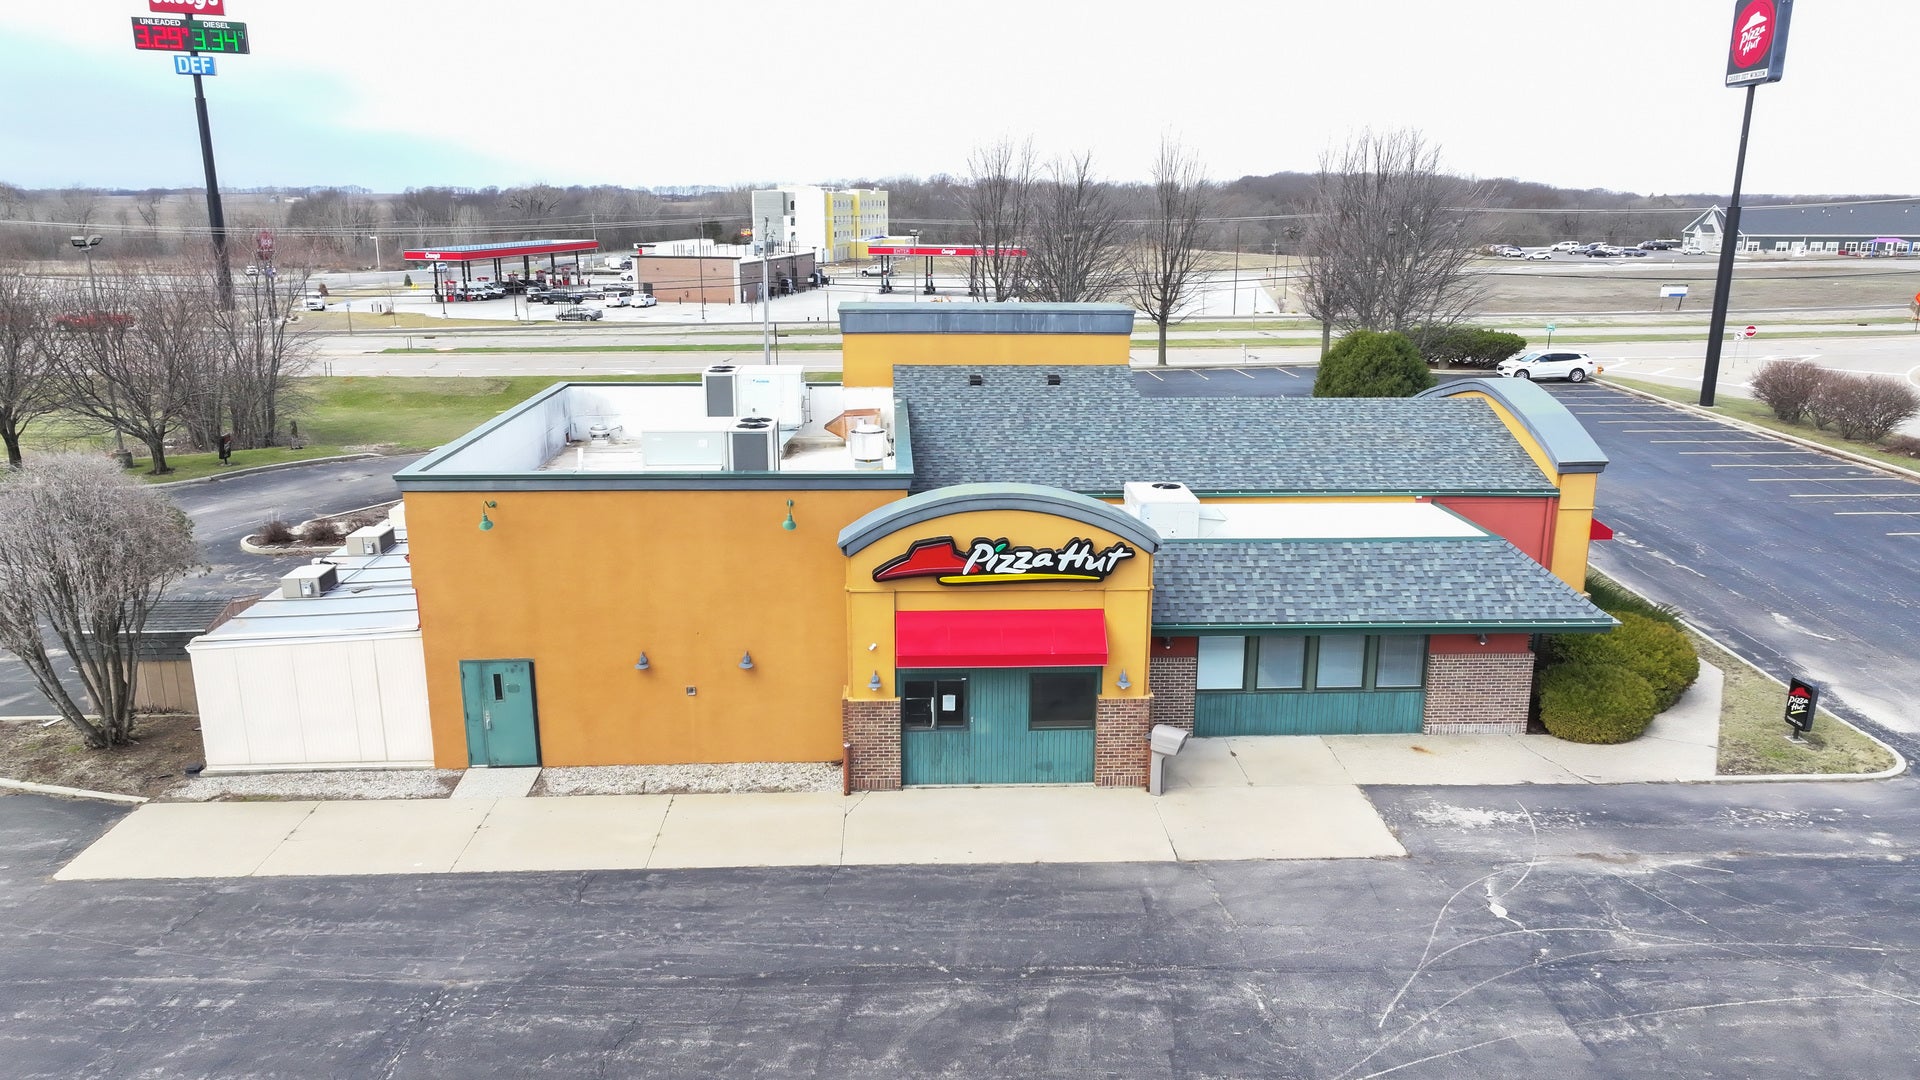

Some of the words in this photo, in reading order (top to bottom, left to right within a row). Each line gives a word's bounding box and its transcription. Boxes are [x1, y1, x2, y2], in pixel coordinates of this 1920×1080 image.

[140, 18, 181, 26] UNLEADED
[203, 21, 230, 29] DIESEL
[1739, 25, 1766, 50] Pizza
[1742, 36, 1762, 56] Hut
[177, 56, 211, 74] DEF
[963, 542, 1053, 575] Pizza
[1058, 542, 1133, 572] Hut
[1788, 695, 1809, 706] Pizza
[1791, 703, 1806, 711] Hut
